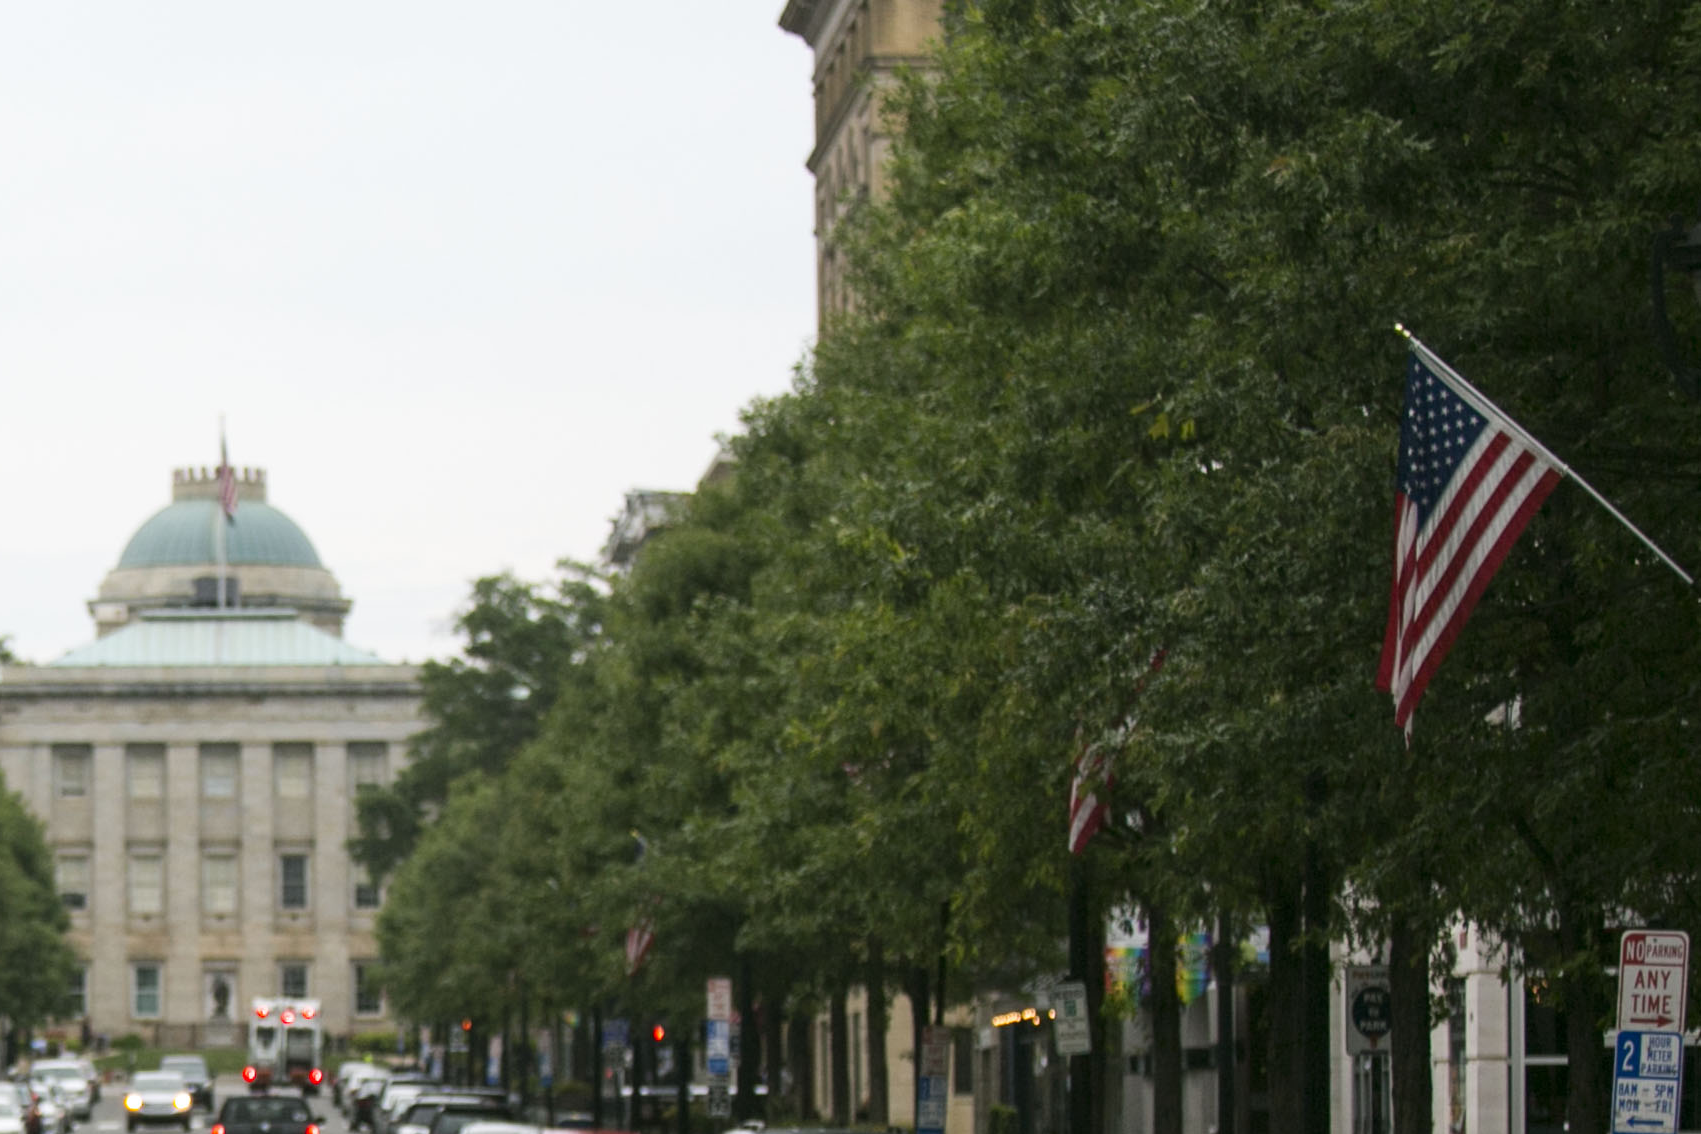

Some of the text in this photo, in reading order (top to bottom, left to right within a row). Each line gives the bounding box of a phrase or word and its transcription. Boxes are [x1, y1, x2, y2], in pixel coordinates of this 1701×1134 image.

[1626, 940, 1683, 961] NO PARKING
[1634, 968, 1672, 991] ANY
[1631, 994, 1672, 1015] TIME
[1648, 1036, 1672, 1049] HOUR
[1621, 1039, 1635, 1072] 2
[1646, 1048, 1673, 1061] METER
[1640, 1062, 1677, 1076] PARKING
[1618, 1082, 1639, 1097] 8AM
[1654, 1083, 1675, 1098] 5PM
[1618, 1099, 1640, 1112] MON
[1655, 1100, 1673, 1114] FRI
